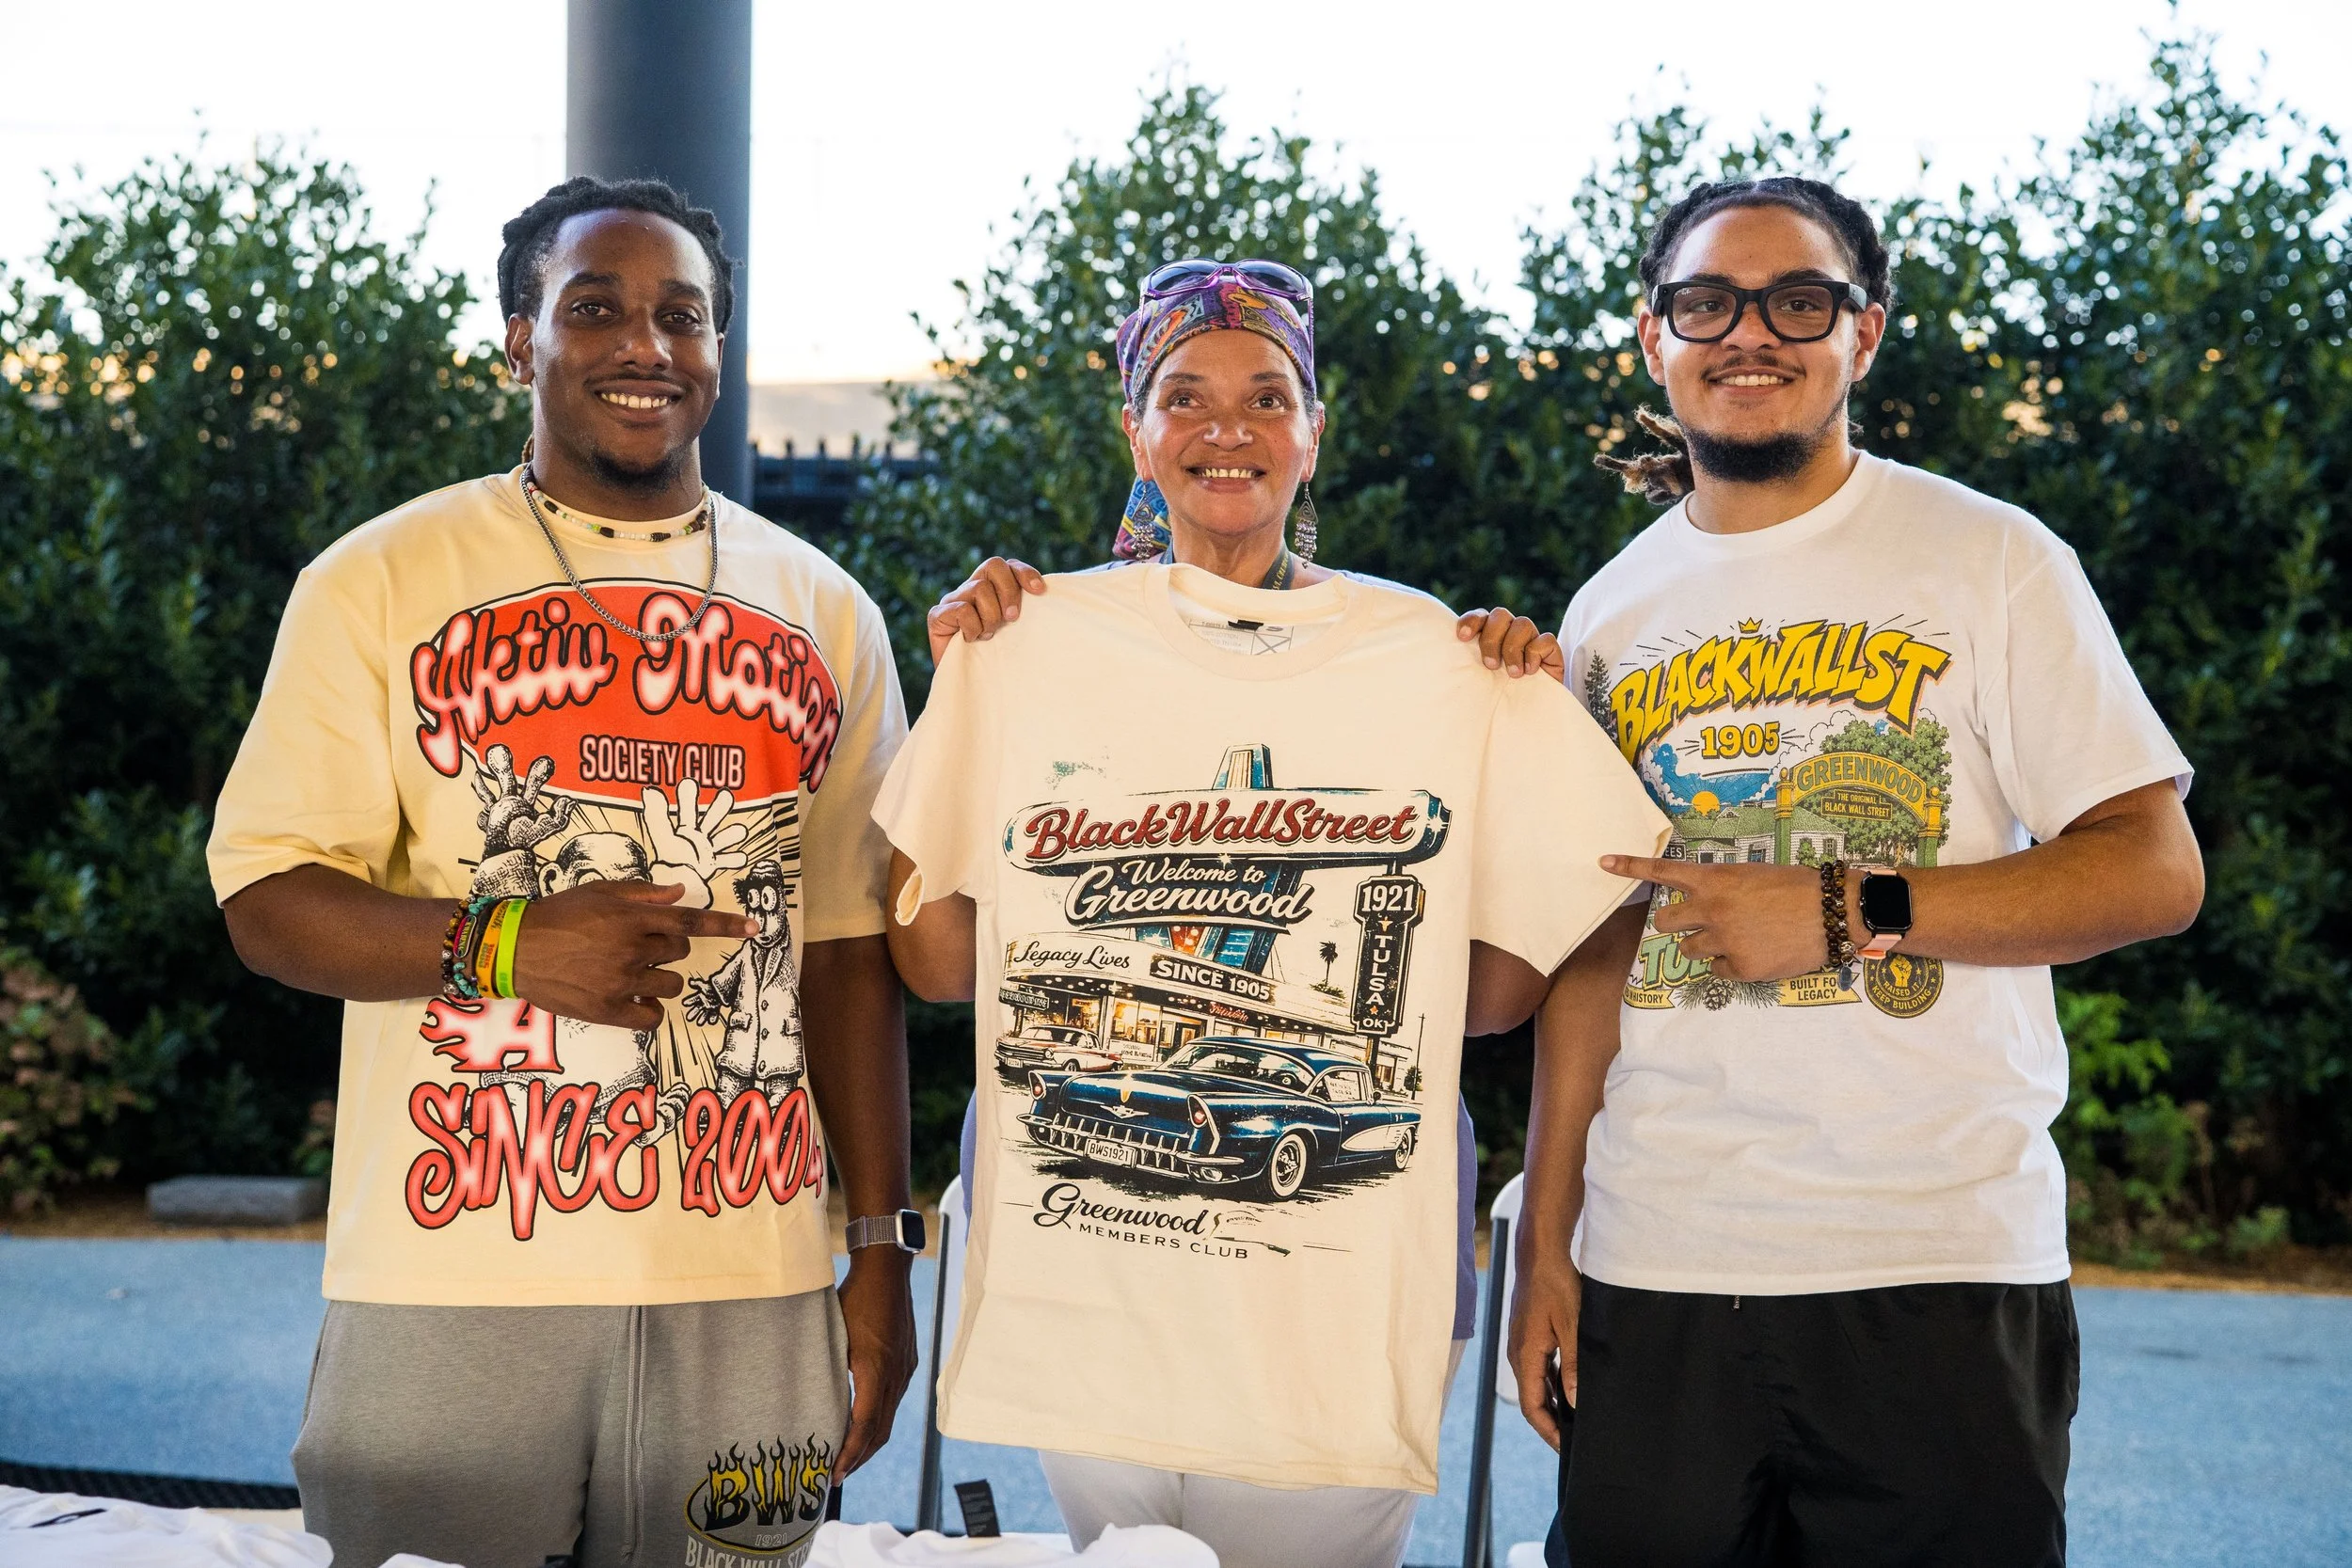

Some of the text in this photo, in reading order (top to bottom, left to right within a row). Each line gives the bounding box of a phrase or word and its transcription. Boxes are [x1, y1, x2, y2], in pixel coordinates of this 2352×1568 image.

[1700, 721, 1780, 760] 1905
[580, 735, 746, 791] SOCIETY CLUB
[1797, 756, 1922, 803] GREENWOOD
[1825, 801, 1890, 817] BLACK WALL STREET
[1837, 792, 1877, 805] THE ORIGINAL
[1120, 857, 1267, 886] Welcome to
[1064, 864, 1315, 922] Greenwood
[1361, 884, 1415, 912] 1921
[1013, 940, 1131, 970] Legacy Lives
[1156, 960, 1271, 1001] SINCE 1905
[1365, 934, 1393, 1006] TULSA
[1789, 976, 1838, 990] BUILT FO
[1798, 989, 1837, 1002] LEGACY
[1871, 985, 1932, 1010] KEEP BUILDING
[1883, 980, 1921, 997] RAISED IT
[1362, 1018, 1384, 1029] OK
[1089, 1143, 1129, 1163] BWS1921
[1078, 1222, 1249, 1259] MEMBERS CLUB
[704, 1432, 835, 1533] BWS
[755, 1532, 788, 1547] 1921
